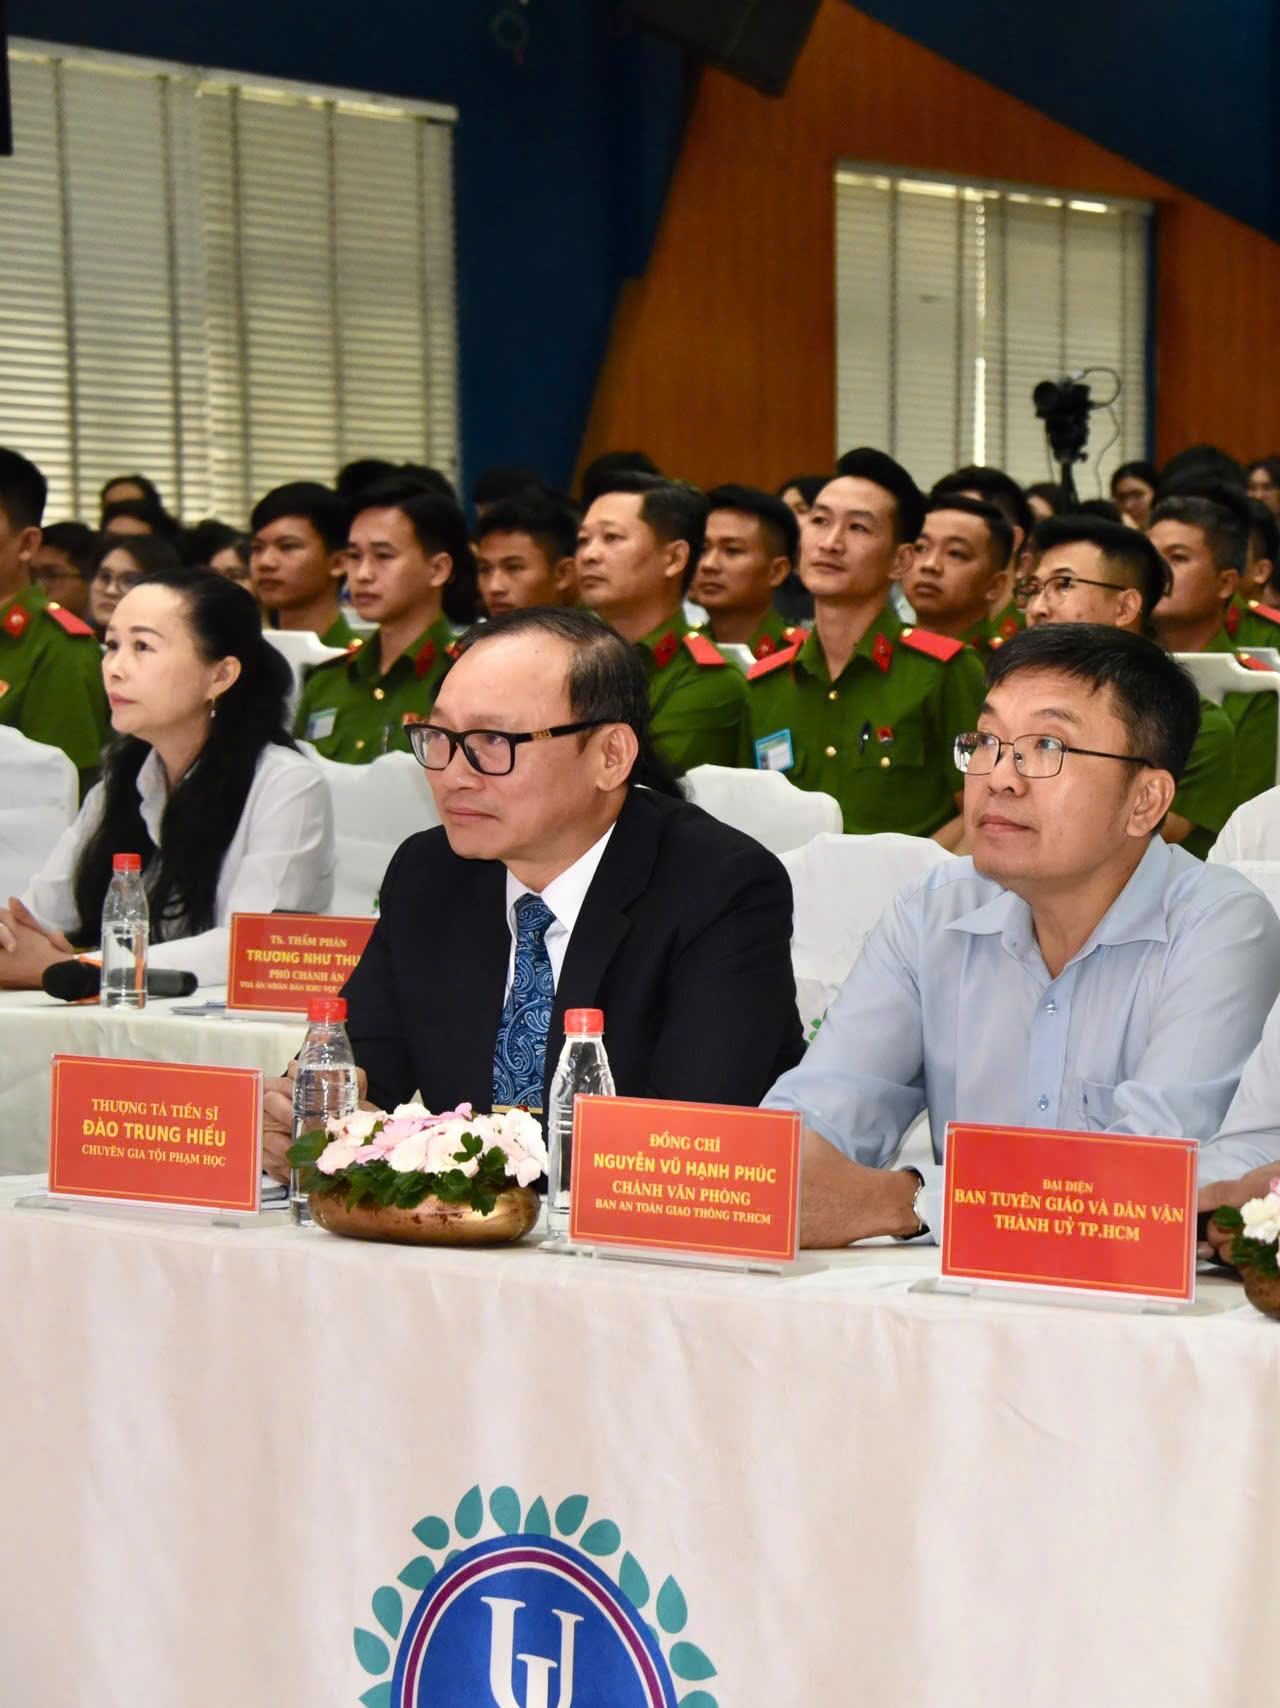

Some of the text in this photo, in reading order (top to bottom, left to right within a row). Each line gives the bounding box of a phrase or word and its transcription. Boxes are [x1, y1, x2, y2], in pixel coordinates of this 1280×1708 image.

[271, 935, 285, 946] TS.
[91, 1098, 147, 1115] THƯỢNG
[170, 1102, 202, 1119] TIẾN
[205, 1106, 219, 1121] SĨ
[82, 1116, 226, 1147] ĐÀO TRUNG HIẾU
[694, 1136, 720, 1153] CHÍ
[81, 1144, 226, 1168] CHUYÊN GIA TỘI PHẠM HỌC
[593, 1152, 776, 1184] NGUYỄN VŨ HẠNH PHÚC
[612, 1179, 751, 1206] CHÁNH VĂN PHÒNG
[1042, 1178, 1094, 1194] ĐẠI DIỆN
[595, 1198, 771, 1225] BAN AN TOÀN GIAO THÔNG TP.HCM
[954, 1188, 985, 1205] BAN
[990, 1191, 1041, 1210] TUYÊN
[1045, 1195, 1084, 1214] GIÁO
[1088, 1198, 1109, 1216] VÀ
[1151, 1204, 1184, 1225] VẬN
[994, 1213, 1049, 1233] THÀNH
[1078, 1221, 1140, 1241] TP.HCM
